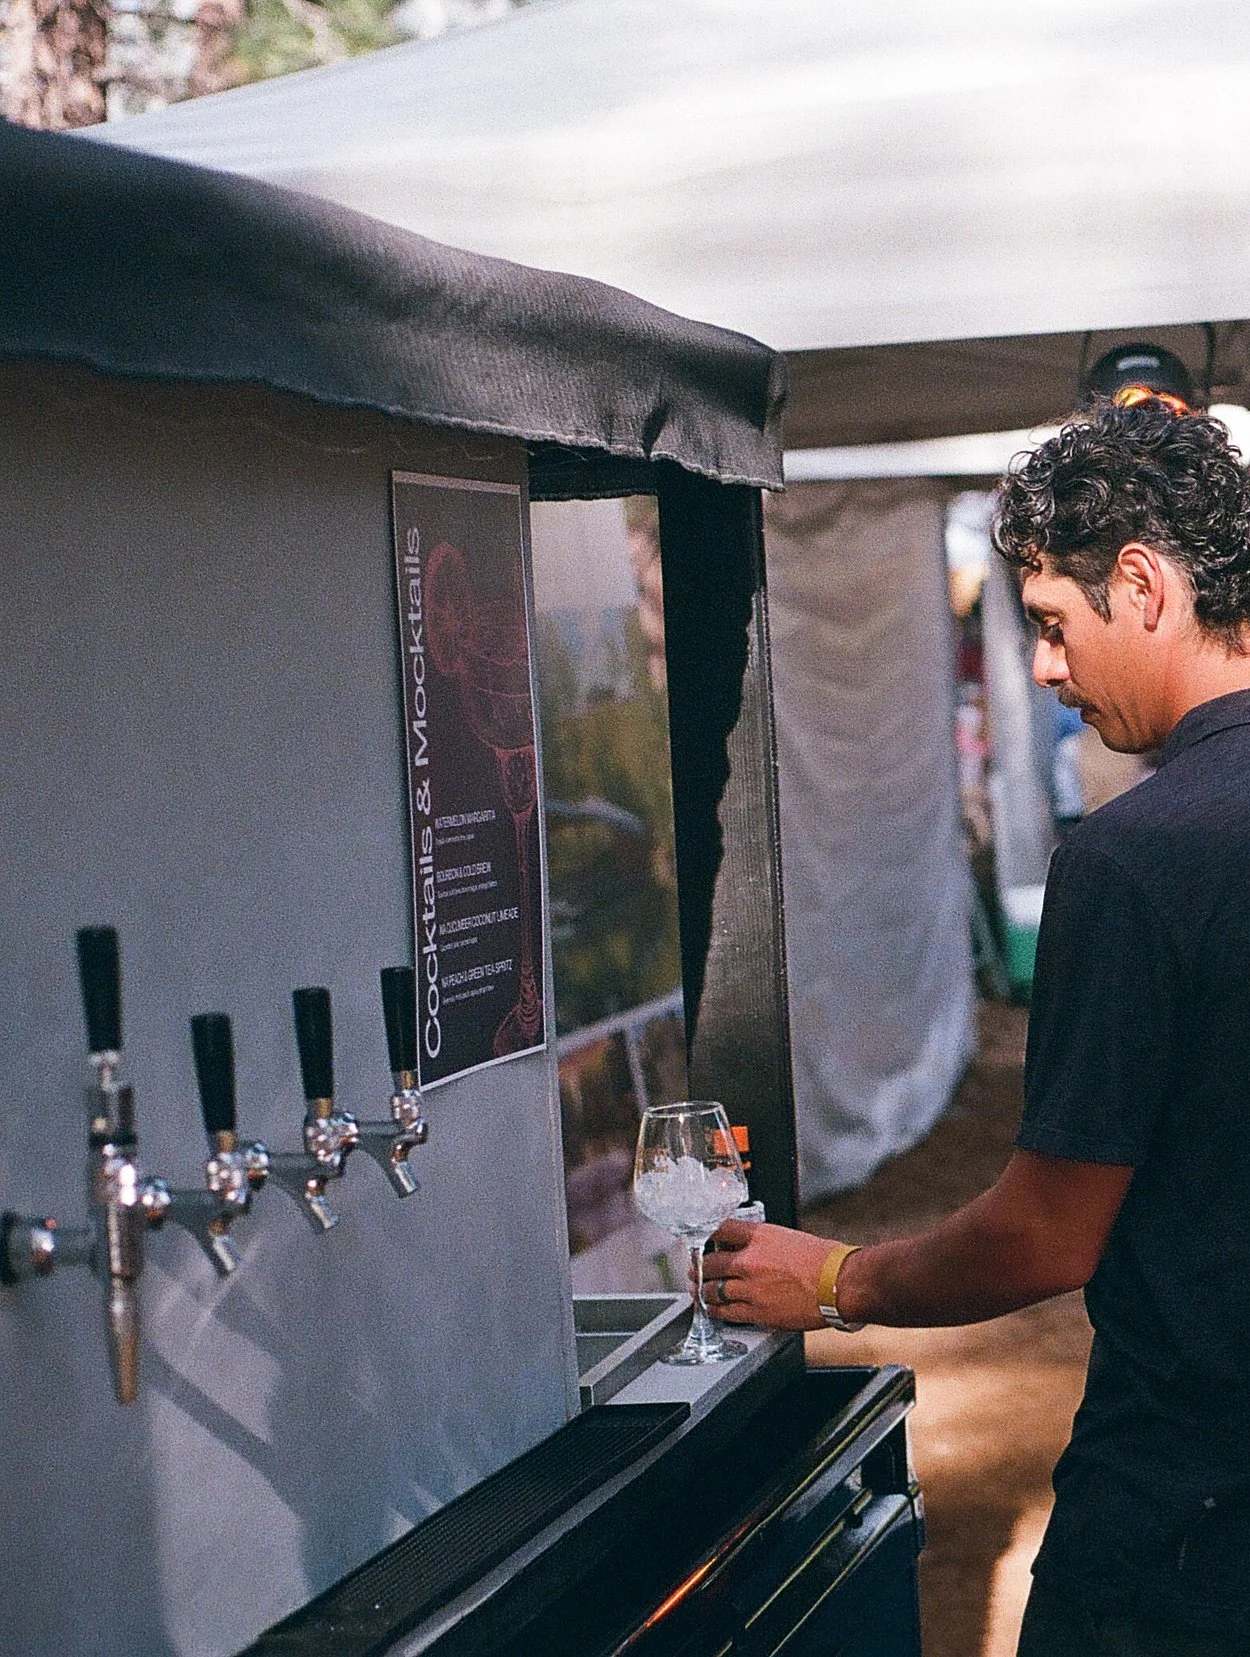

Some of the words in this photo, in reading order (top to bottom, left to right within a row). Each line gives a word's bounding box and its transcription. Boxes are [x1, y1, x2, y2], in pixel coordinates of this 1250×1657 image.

[404, 527, 429, 767] Mocktails
[416, 777, 432, 815] &
[472, 911, 496, 927] COCONUT
[496, 906, 519, 922] LIMEADE
[419, 825, 442, 1059] Cocktails
[468, 966, 484, 981] GREEN
[484, 963, 495, 976] TEA
[495, 959, 513, 974] SPRITZ
